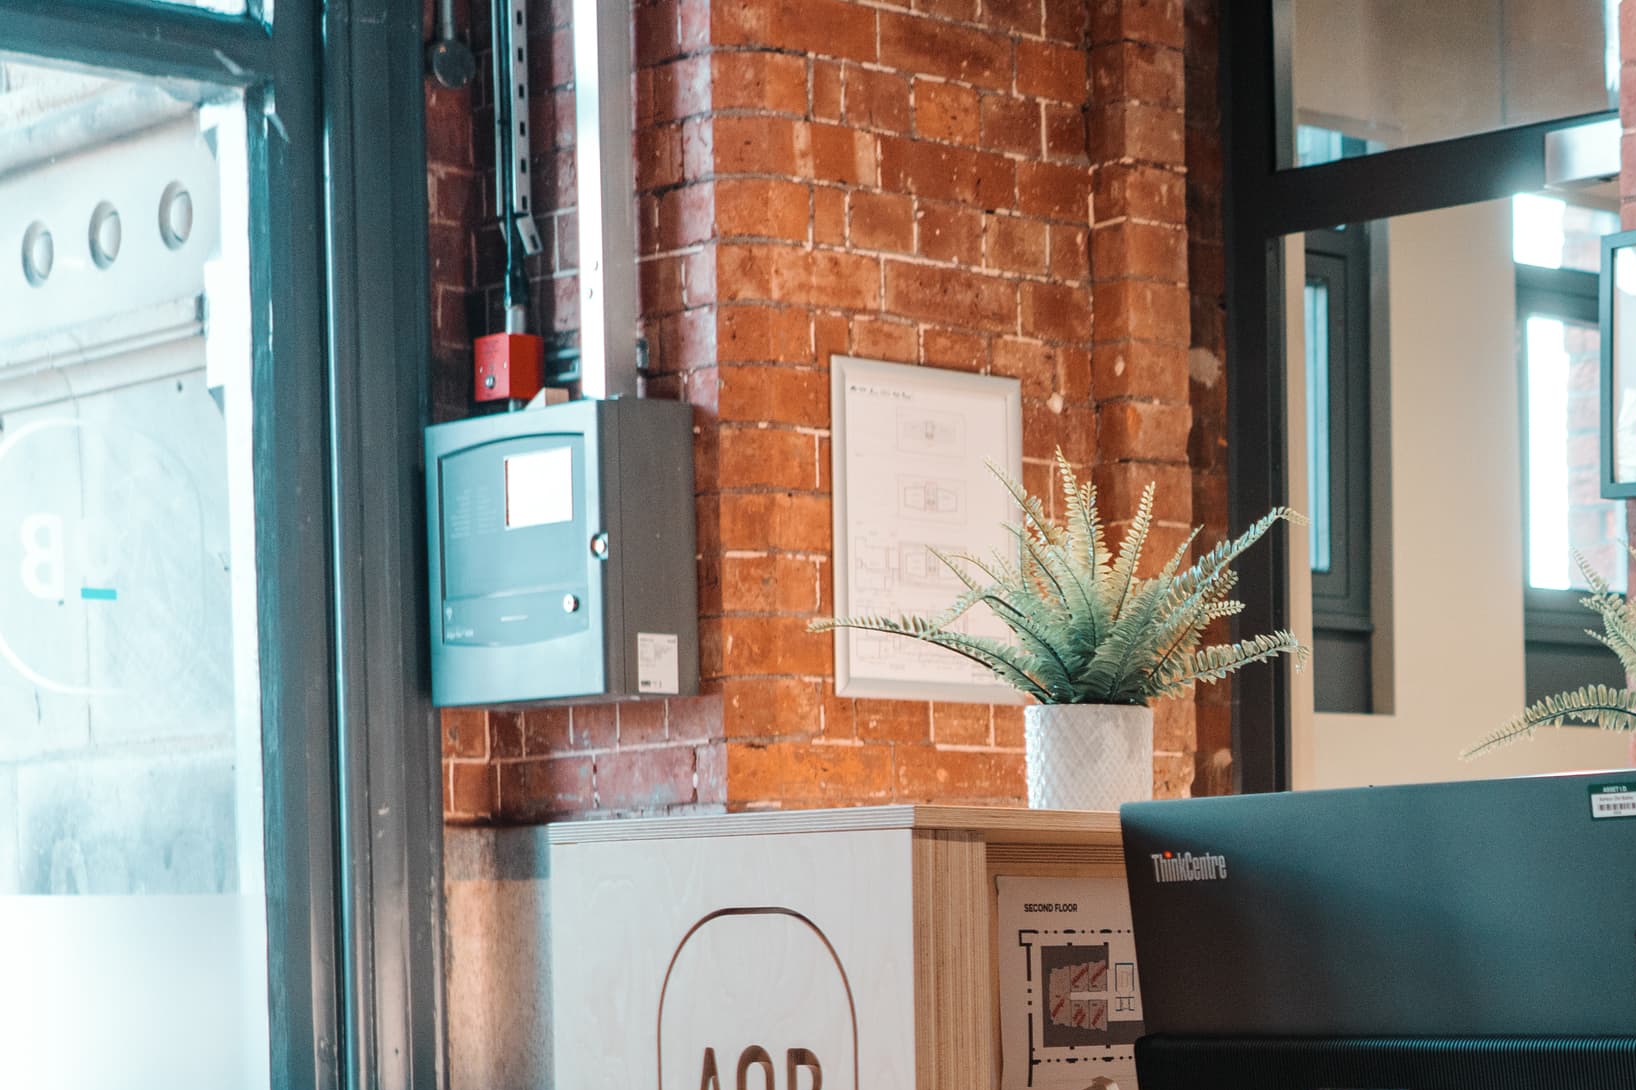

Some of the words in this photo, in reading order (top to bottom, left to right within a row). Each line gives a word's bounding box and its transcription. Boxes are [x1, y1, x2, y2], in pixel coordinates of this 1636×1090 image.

[1150, 850, 1228, 883] ThinkCentre
[1023, 903, 1054, 913] SECOND
[1055, 903, 1078, 913] FLOOR
